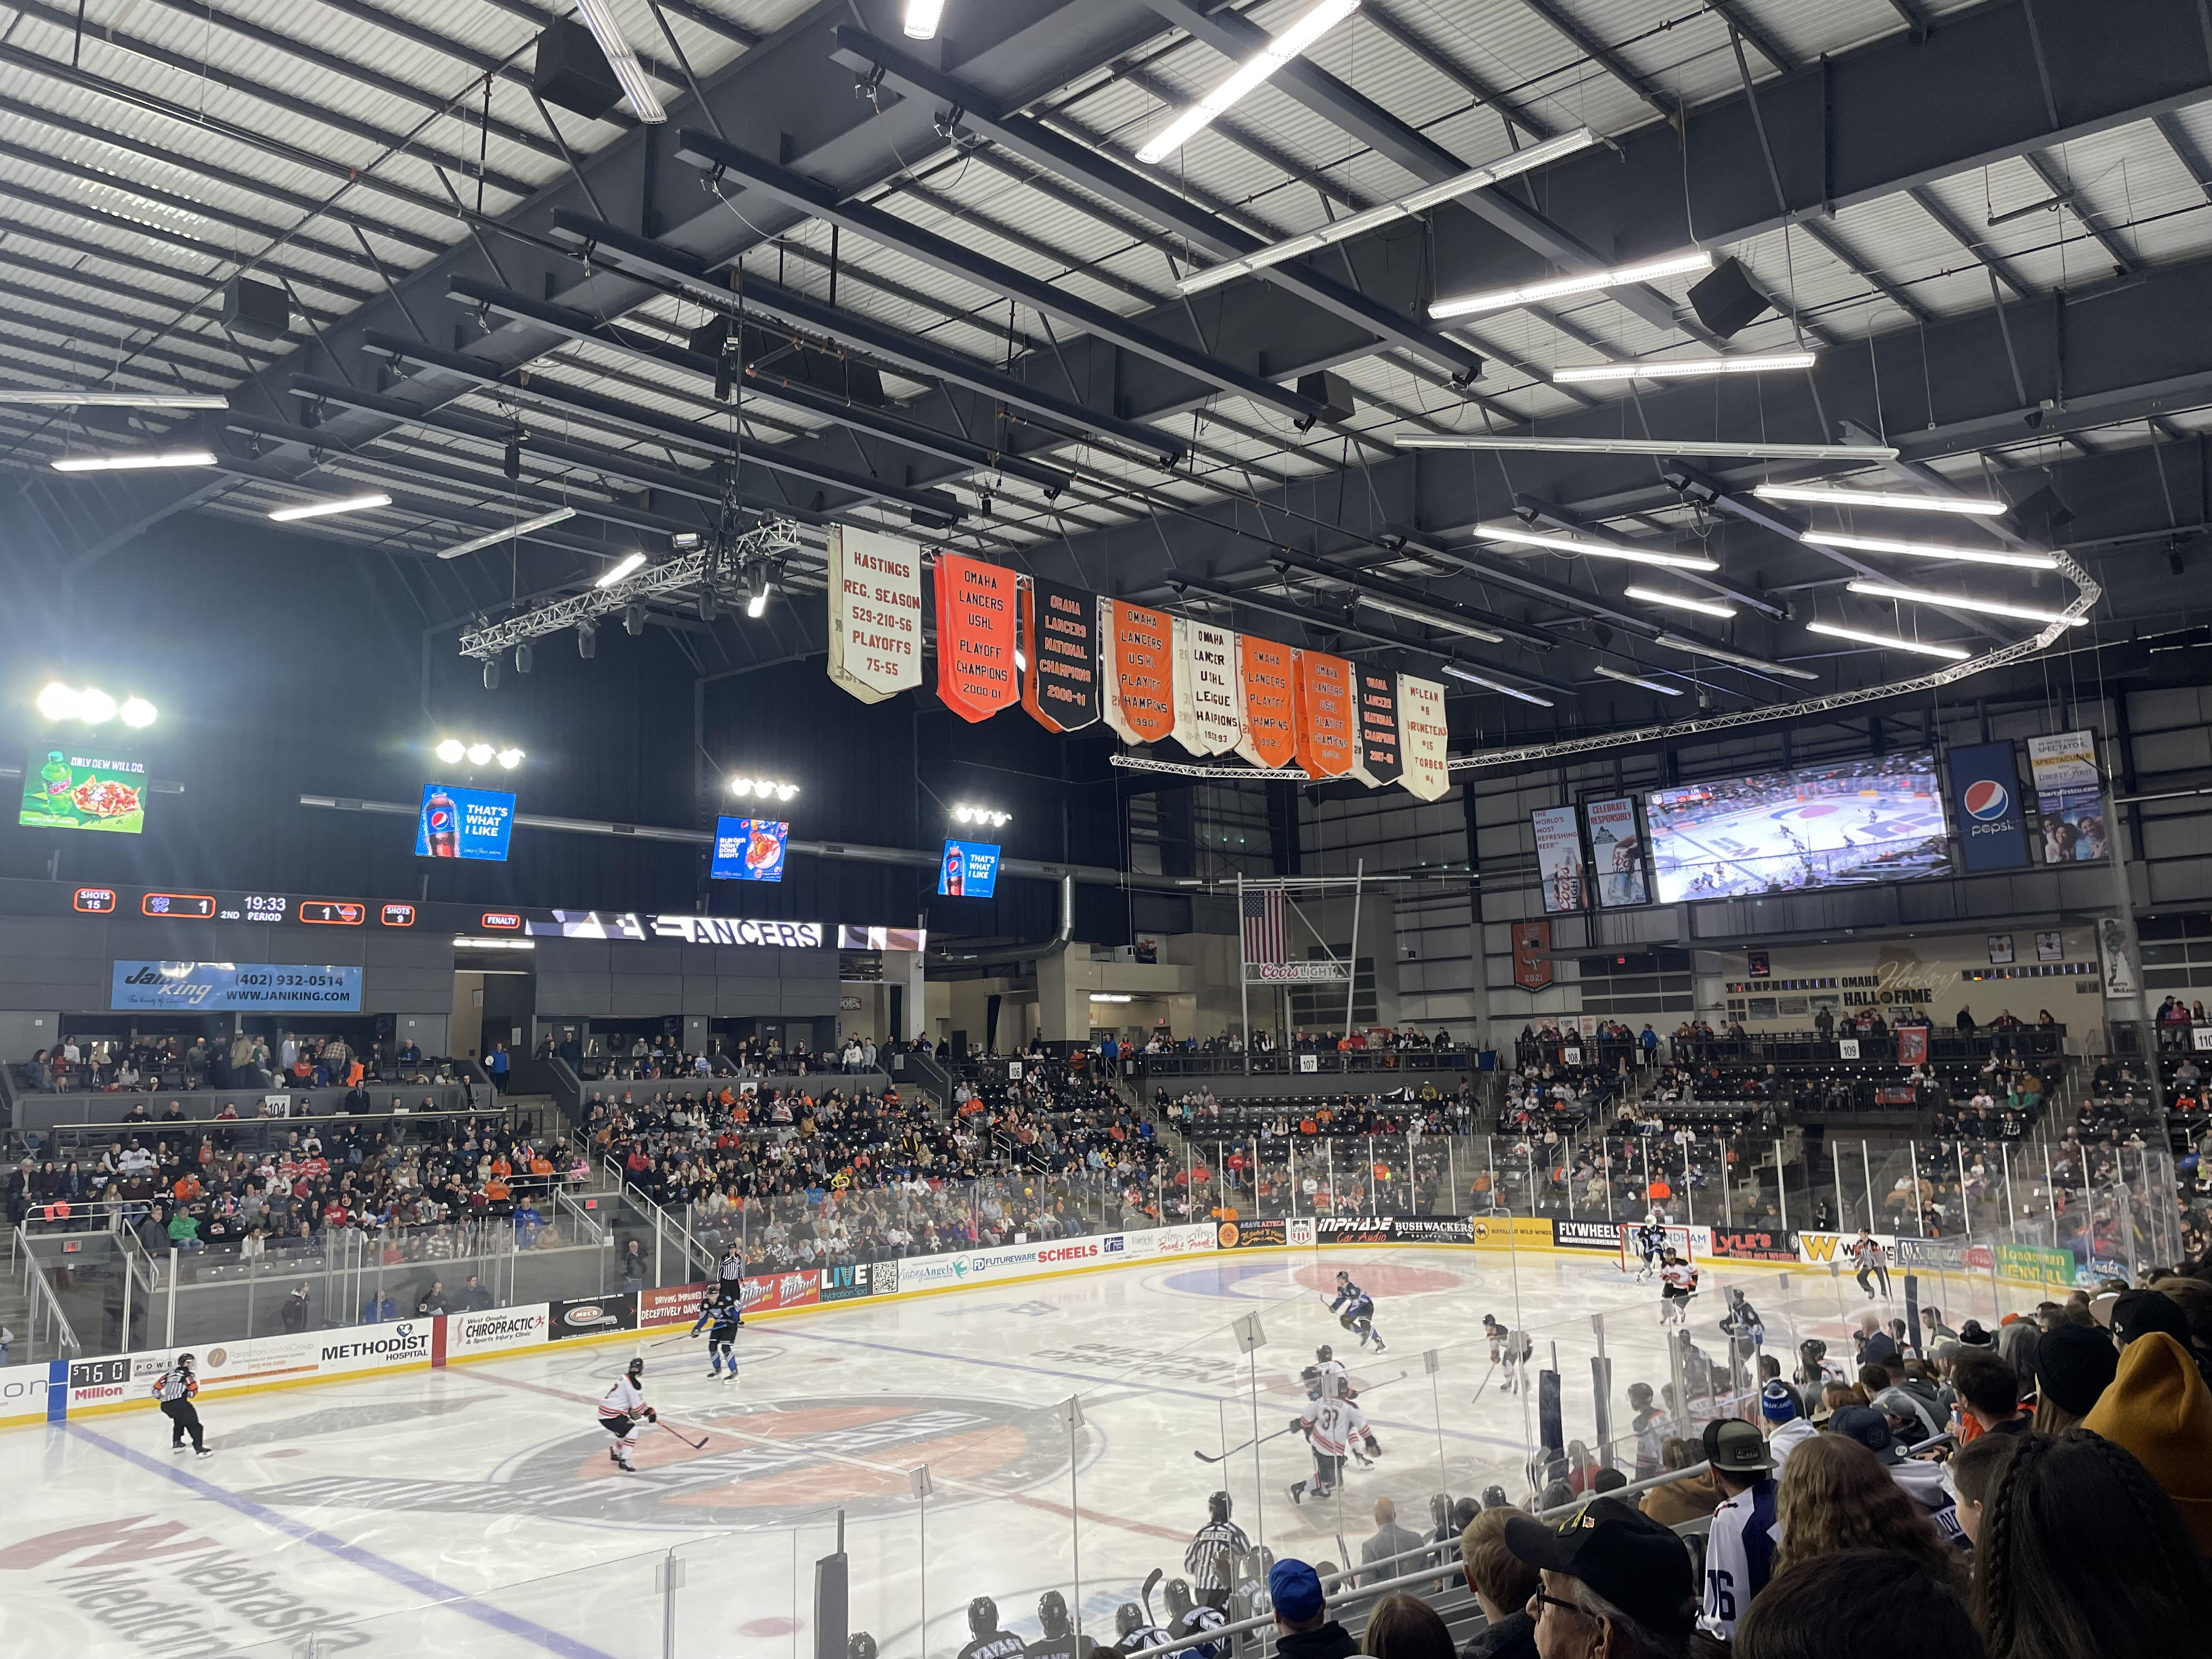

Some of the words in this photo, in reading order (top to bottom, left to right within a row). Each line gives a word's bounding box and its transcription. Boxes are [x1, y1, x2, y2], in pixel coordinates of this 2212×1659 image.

[854, 552, 910, 578] HASTINGS
[964, 570, 997, 590] OMAHA
[844, 579, 870, 599] REG.
[875, 588, 920, 609] SEASON
[959, 590, 1003, 611] LANCERS
[1050, 595, 1080, 616] OMAHA
[852, 606, 912, 631] 529-210-56
[968, 613, 994, 630] USHL
[1128, 611, 1157, 628] OMAHA
[1045, 616, 1086, 638] LANCERS
[853, 630, 911, 655] PLAYOFFS
[1121, 631, 1161, 650] LANCERS
[1198, 631, 1224, 646] OMAHA
[960, 639, 1002, 659] PLAYOFF
[1045, 637, 1087, 659] NATIONAL
[1129, 653, 1155, 669] USHL
[1194, 649, 1224, 665] LANCER
[1254, 651, 1280, 666] OMAHA
[867, 657, 898, 675] 75-55
[956, 660, 1008, 681] CHAMPIONS
[1040, 659, 1091, 682] CHAMPIONS
[1316, 665, 1338, 680] OMAHA
[1200, 670, 1224, 685] USHL
[1249, 672, 1285, 689] LANCERS
[1365, 676, 1388, 691] OMAHA
[963, 683, 1001, 699] 2000-01
[1312, 680, 1344, 697] LANCERS
[1125, 695, 1167, 713] HAMPONS
[1250, 694, 1284, 709] PLAYOFF
[1320, 699, 1338, 713] USHL
[1364, 693, 1392, 709] LANCERS
[1422, 741, 1433, 751] #15
[71, 757, 90, 768] ONLY
[92, 759, 111, 769] DEW
[112, 760, 131, 772] WILL
[131, 763, 145, 773] DO.
[1415, 757, 1443, 770] FORBES
[466, 804, 508, 817] THAT'S
[1592, 802, 1627, 814] CELEBRATE
[466, 815, 501, 826] WHAT
[1536, 816, 1564, 826] WORLD'S
[1590, 812, 1632, 825] RESPONSIBLY
[465, 825, 469, 834] I
[472, 826, 499, 837] LIKE
[1971, 820, 2011, 837] pepsi
[1537, 831, 1577, 842] REFRESHING
[969, 862, 991, 871] WHAT
[970, 854, 995, 864] THAT'S
[973, 871, 989, 879] LIKE
[81, 891, 110, 900] SHOTS
[87, 900, 100, 909] 15
[199, 900, 207, 913] 1
[244, 896, 286, 911] 19:33
[221, 910, 240, 920] 2ND
[247, 912, 281, 922] PERIOD
[322, 906, 330, 920] 1
[397, 915, 403, 923] 9
[487, 917, 516, 925] PENALTY
[1261, 963, 1300, 979] Coors
[1300, 966, 1334, 977] LIGHT
[235, 974, 272, 986] (402)
[276, 974, 343, 987] 932-0514
[1842, 975, 1879, 988] OMAHA
[1875, 960, 1959, 1003] Hockey
[226, 990, 350, 1001] WWW.JANIKING.COM
[1843, 991, 1880, 1006] HALL
[1894, 989, 1932, 1004] FAME
[1567, 1053, 1578, 1063] 108
[1843, 1046, 1856, 1057] 109
[1011, 1067, 1020, 1077] 106
[1303, 1060, 1314, 1070] 107
[269, 1103, 285, 1118] 104
[1396, 1221, 1474, 1233] BUSHWACKERS
[1559, 1222, 1620, 1238] FLYWHEELS
[1188, 1238, 1215, 1250] Frank's
[1336, 1232, 1354, 1243] Car
[1358, 1231, 1387, 1243] Audio
[1668, 1232, 1706, 1244] NDHAM
[1711, 1230, 1771, 1254] LYLE'S
[1037, 1244, 1098, 1263] SCHEELS
[1159, 1239, 1184, 1253] Frank's
[974, 1259, 985, 1270] FD
[985, 1253, 1036, 1266] FUTUREWARE
[1730, 1249, 1752, 1259] TIRES
[1754, 1251, 1767, 1260] and
[898, 1267, 926, 1283] Visiting
[925, 1264, 953, 1276] Angels
[2092, 1256, 2119, 1276] maha
[780, 1274, 817, 1300] Hiland
[821, 1288, 854, 1301] Hydration
[854, 1287, 867, 1296] Spa
[655, 1295, 676, 1305] DRIVING
[678, 1291, 702, 1302] IMPAIRED
[641, 1306, 681, 1321] DECEPTIVELY
[683, 1303, 701, 1314] DANG
[466, 1317, 534, 1338] CHIROPRACTIC
[473, 1335, 494, 1344] Sports
[495, 1334, 514, 1342] Injury
[321, 1335, 429, 1361] METHODIST
[386, 1349, 428, 1361] HOSPITAL
[136, 1361, 174, 1371] POWE
[75, 1386, 123, 1401] Million
[154, 1549, 373, 1653] Nebraska
[46, 1567, 259, 1659] Medicin
